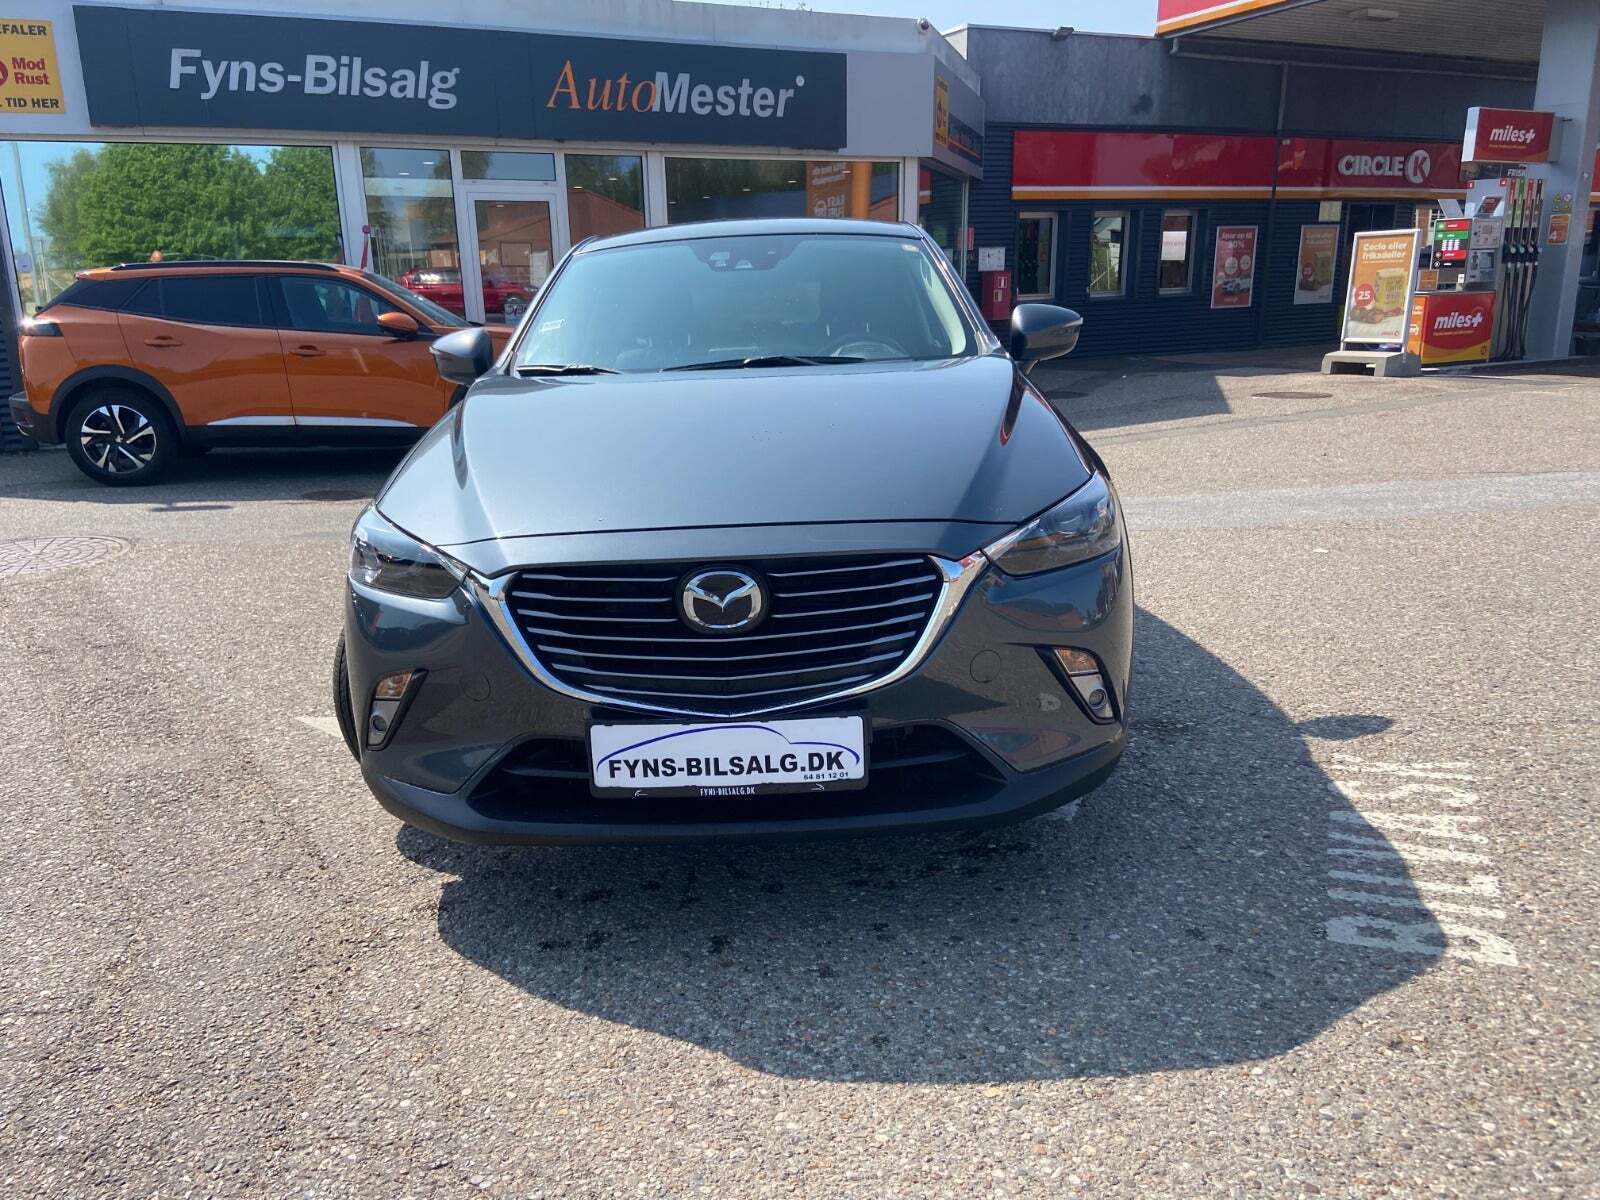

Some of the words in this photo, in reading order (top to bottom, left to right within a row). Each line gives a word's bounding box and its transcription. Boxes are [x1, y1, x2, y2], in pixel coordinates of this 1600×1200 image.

[11, 56, 46, 71] Mod
[13, 72, 50, 85] Rust
[168, 47, 461, 110] Fyns-Bilsalg
[546, 59, 795, 118] AutoMester
[5, 97, 27, 108] TID
[31, 98, 60, 109] HER
[1489, 125, 1536, 144] miles+
[1338, 154, 1405, 177] CIRCLE
[1409, 150, 1430, 183] K
[1358, 290, 1371, 300] 25
[1434, 312, 1484, 330] miles+
[609, 750, 846, 779] FYNS-BILSALG.DK
